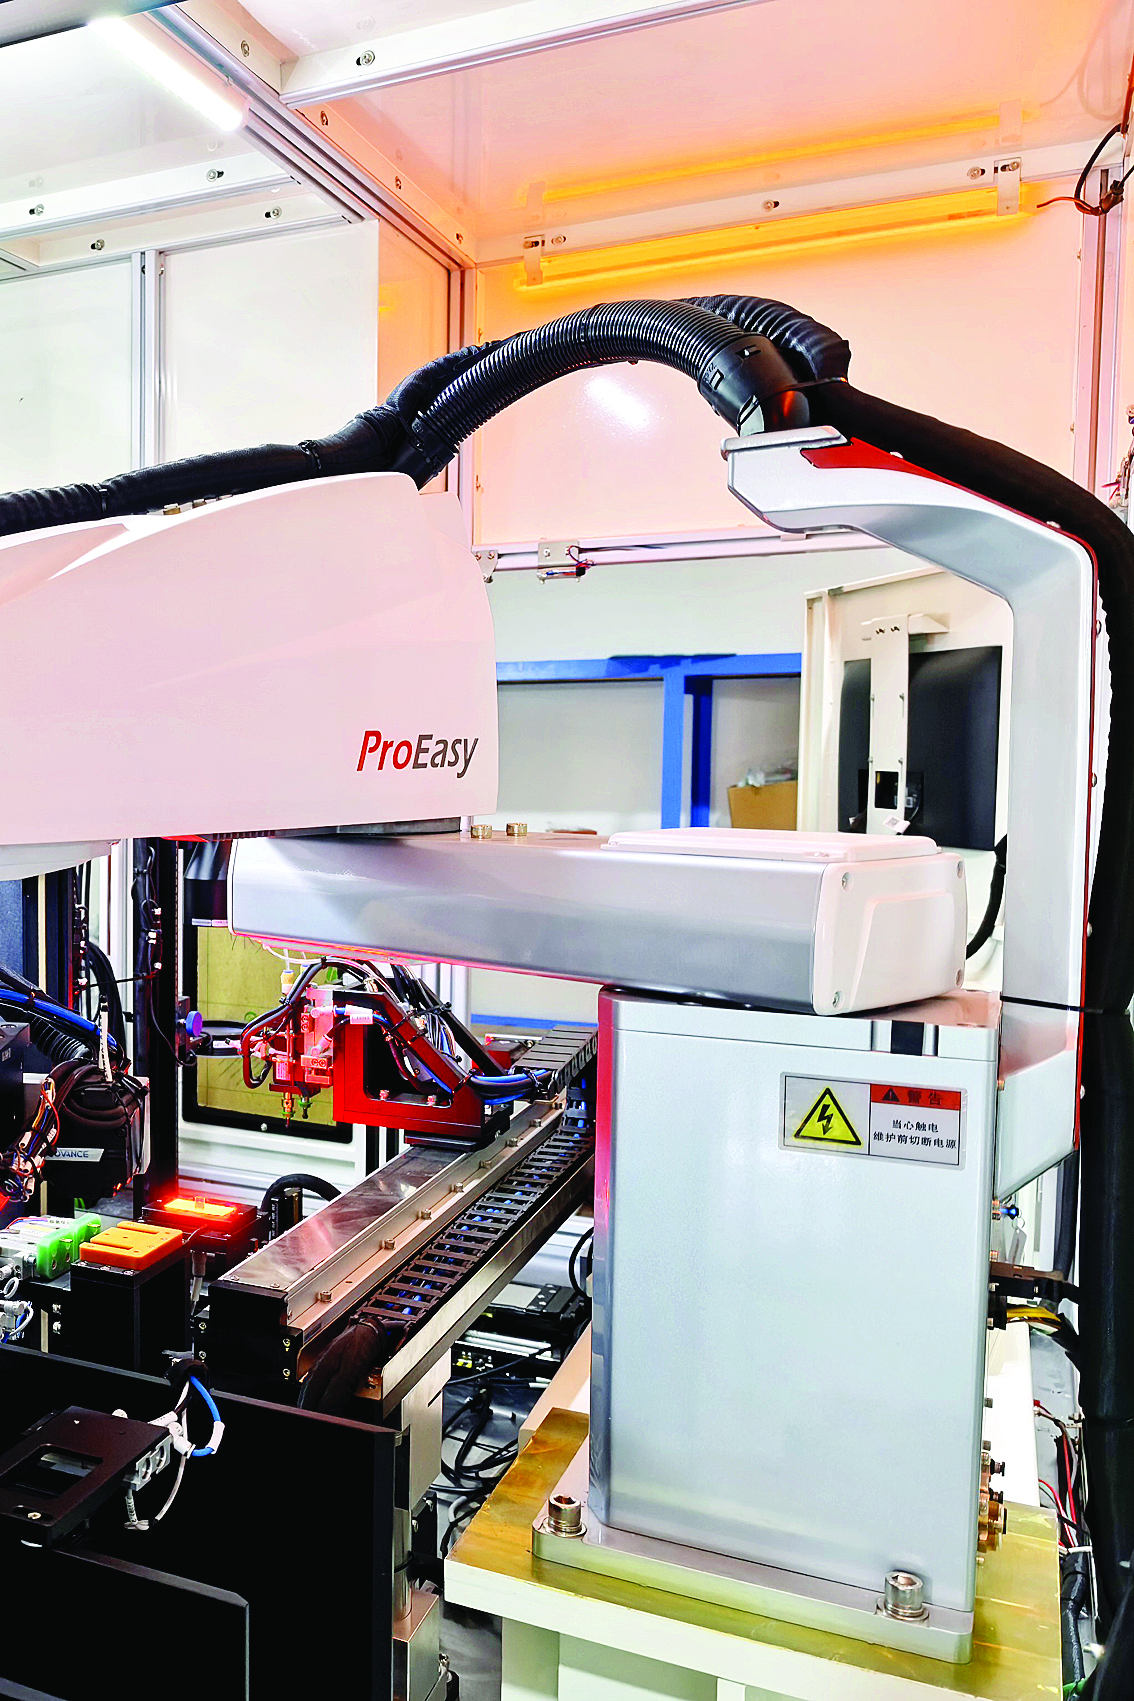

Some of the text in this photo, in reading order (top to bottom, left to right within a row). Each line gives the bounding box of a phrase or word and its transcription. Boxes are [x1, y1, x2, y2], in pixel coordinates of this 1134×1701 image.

[356, 729, 480, 779] ProEasy
[892, 1118, 939, 1133] 当心触电
[872, 1130, 957, 1150] 维护前切断电源
